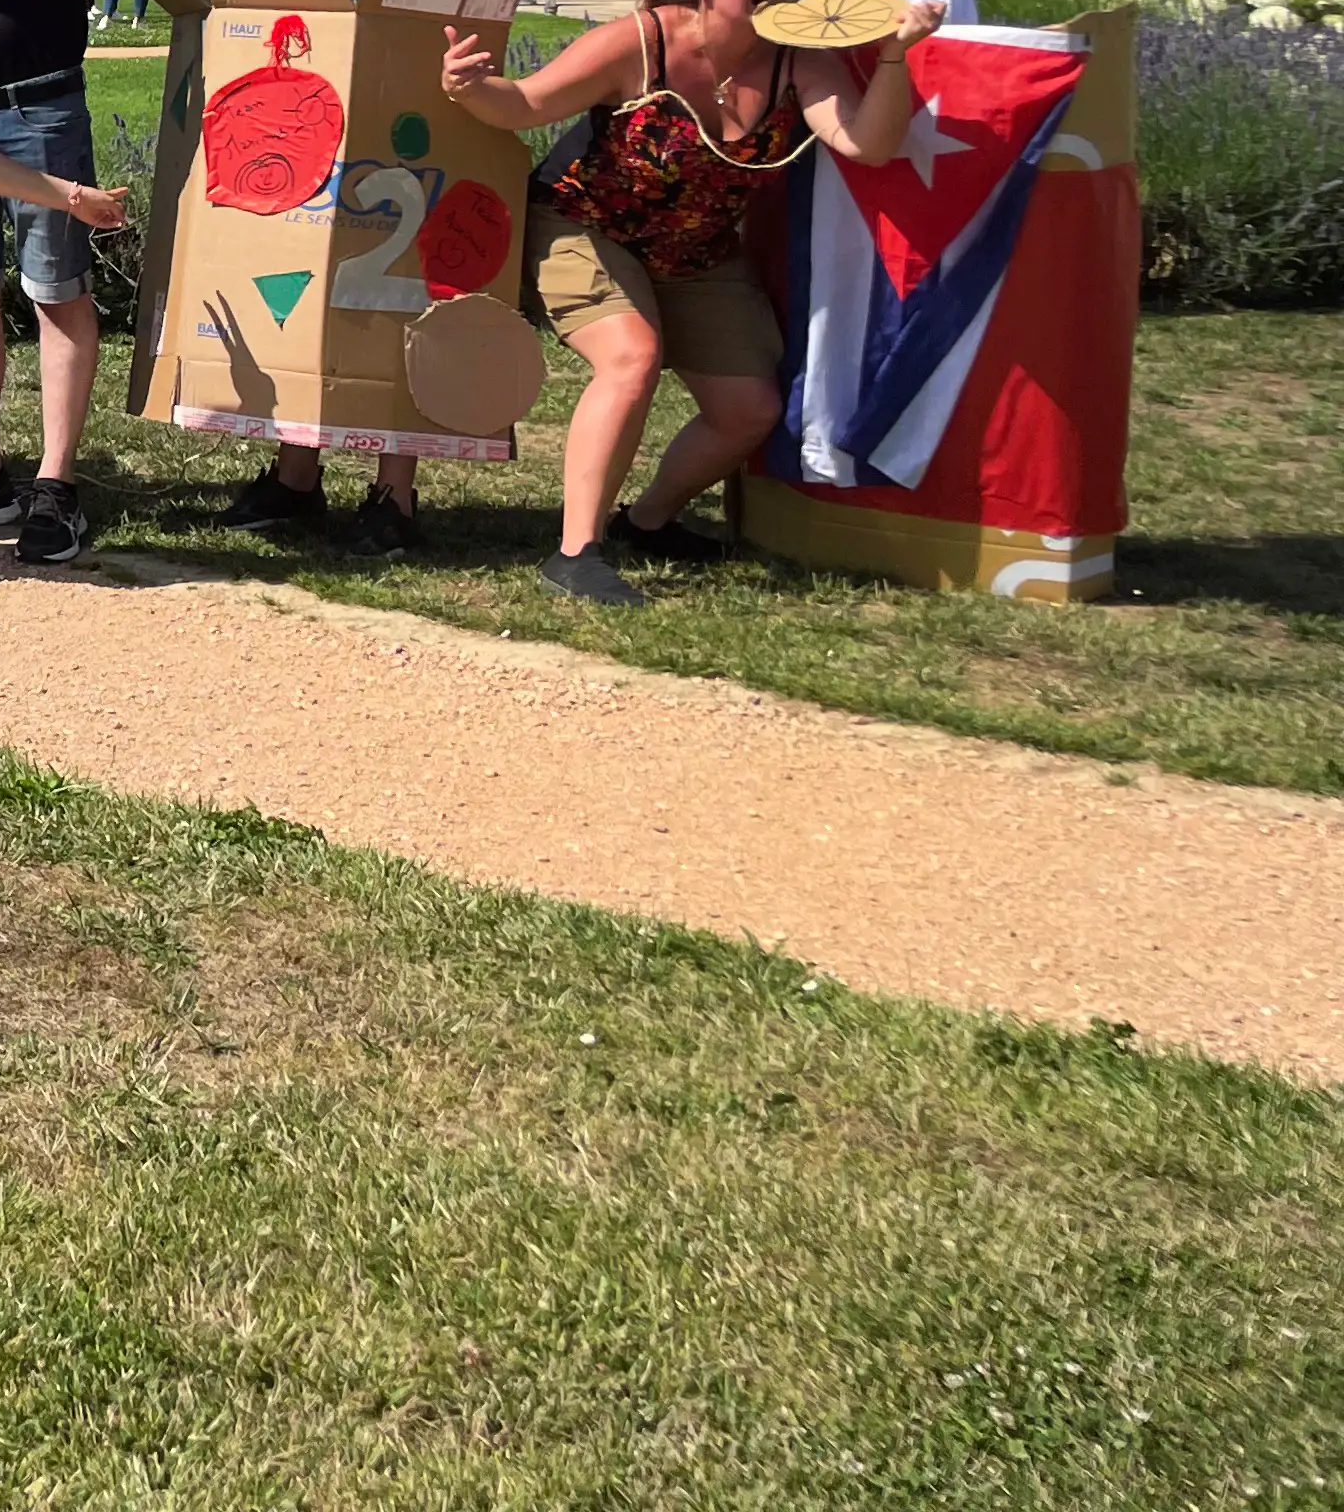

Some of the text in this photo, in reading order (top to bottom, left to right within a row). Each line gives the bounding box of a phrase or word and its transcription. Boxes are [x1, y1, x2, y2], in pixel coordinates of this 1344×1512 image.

[229, 23, 263, 35] HAUT
[285, 213, 302, 223] LE
[330, 168, 428, 311] 2
